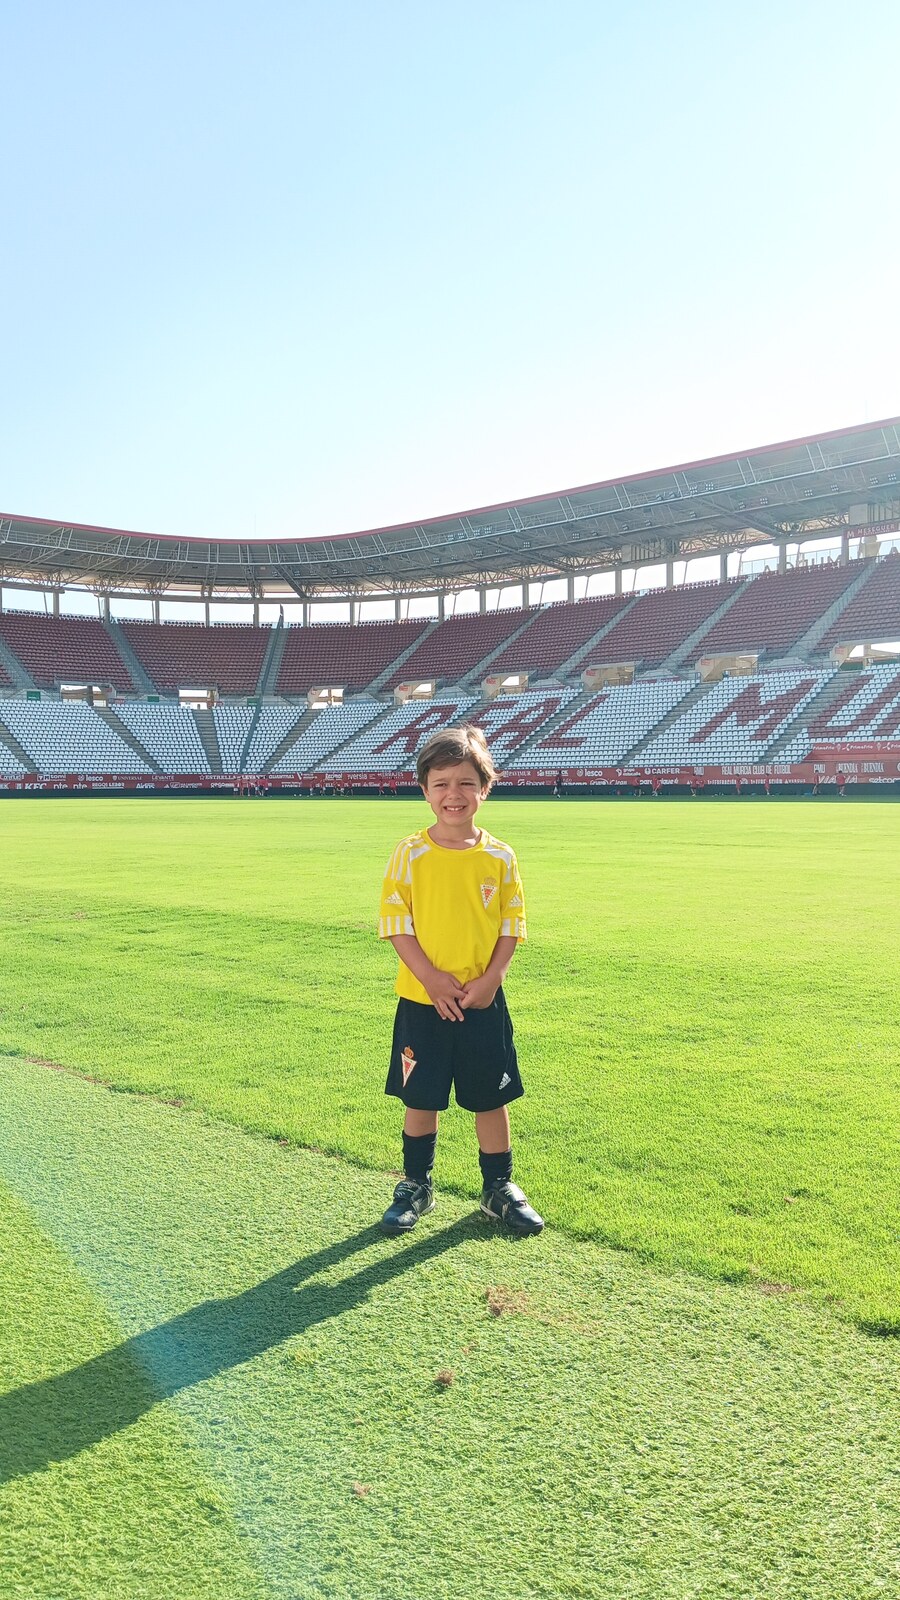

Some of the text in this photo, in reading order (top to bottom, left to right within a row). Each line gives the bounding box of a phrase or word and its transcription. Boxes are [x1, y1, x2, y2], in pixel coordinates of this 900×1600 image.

[858, 524, 895, 534] MESEGUER
[370, 693, 610, 754] REAL
[651, 767, 680, 775] CARFER
[722, 766, 732, 775] REAL
[733, 766, 751, 775] MURCIA
[752, 765, 765, 775] CLUB
[765, 765, 773, 774] DE
